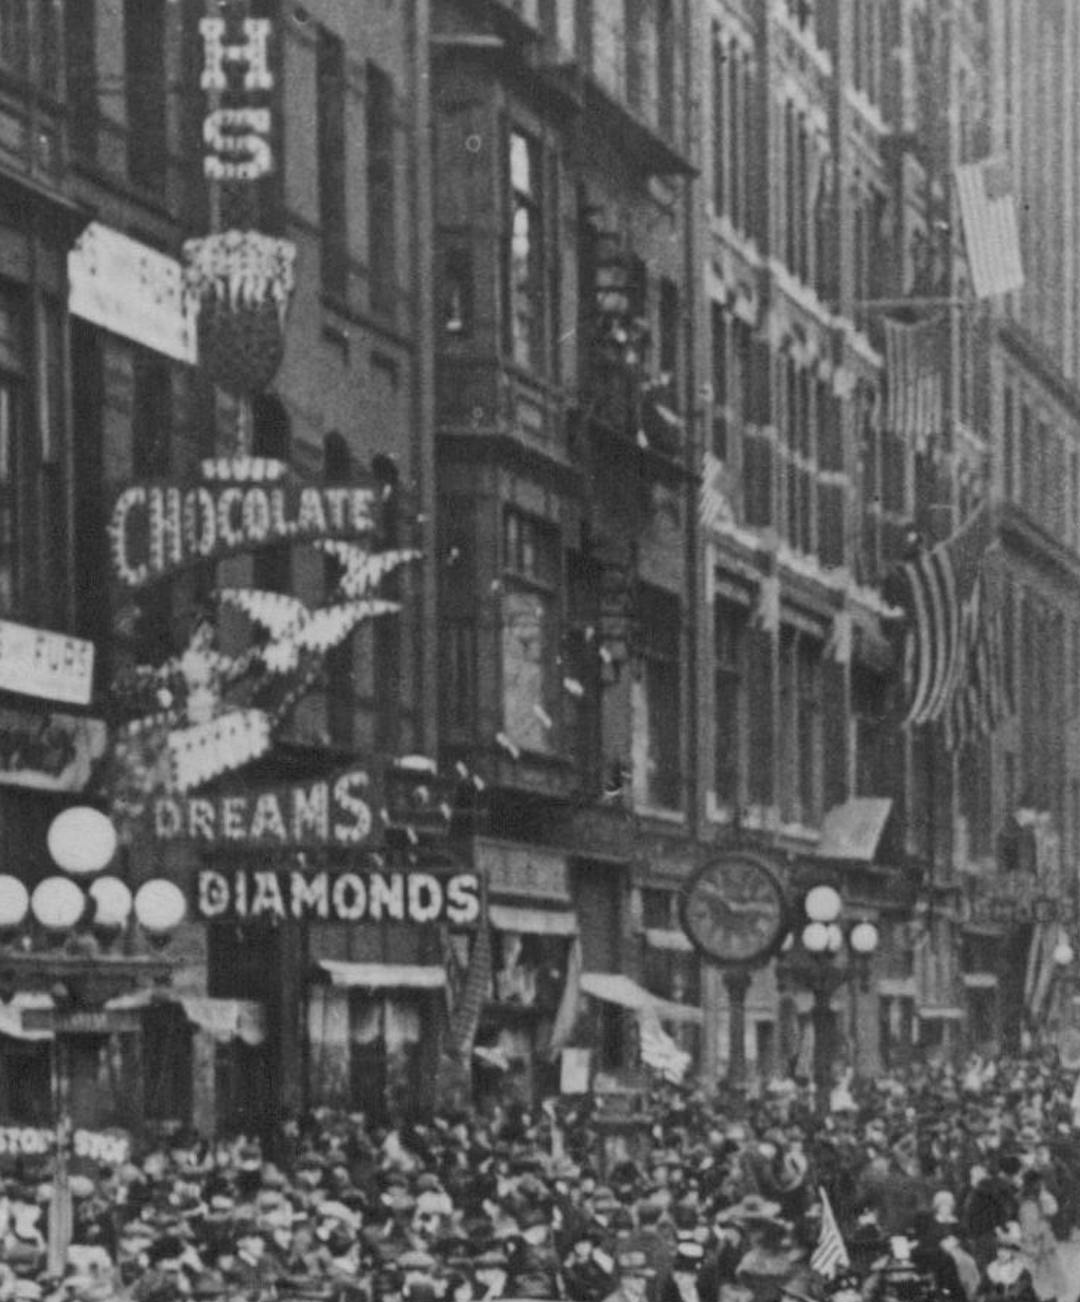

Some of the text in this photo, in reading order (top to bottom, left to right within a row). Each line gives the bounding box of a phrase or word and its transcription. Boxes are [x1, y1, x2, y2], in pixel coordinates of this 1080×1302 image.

[111, 487, 375, 585] CHOCOLATE
[154, 771, 373, 843] DREAMS
[198, 873, 481, 924] DIAMONDS
